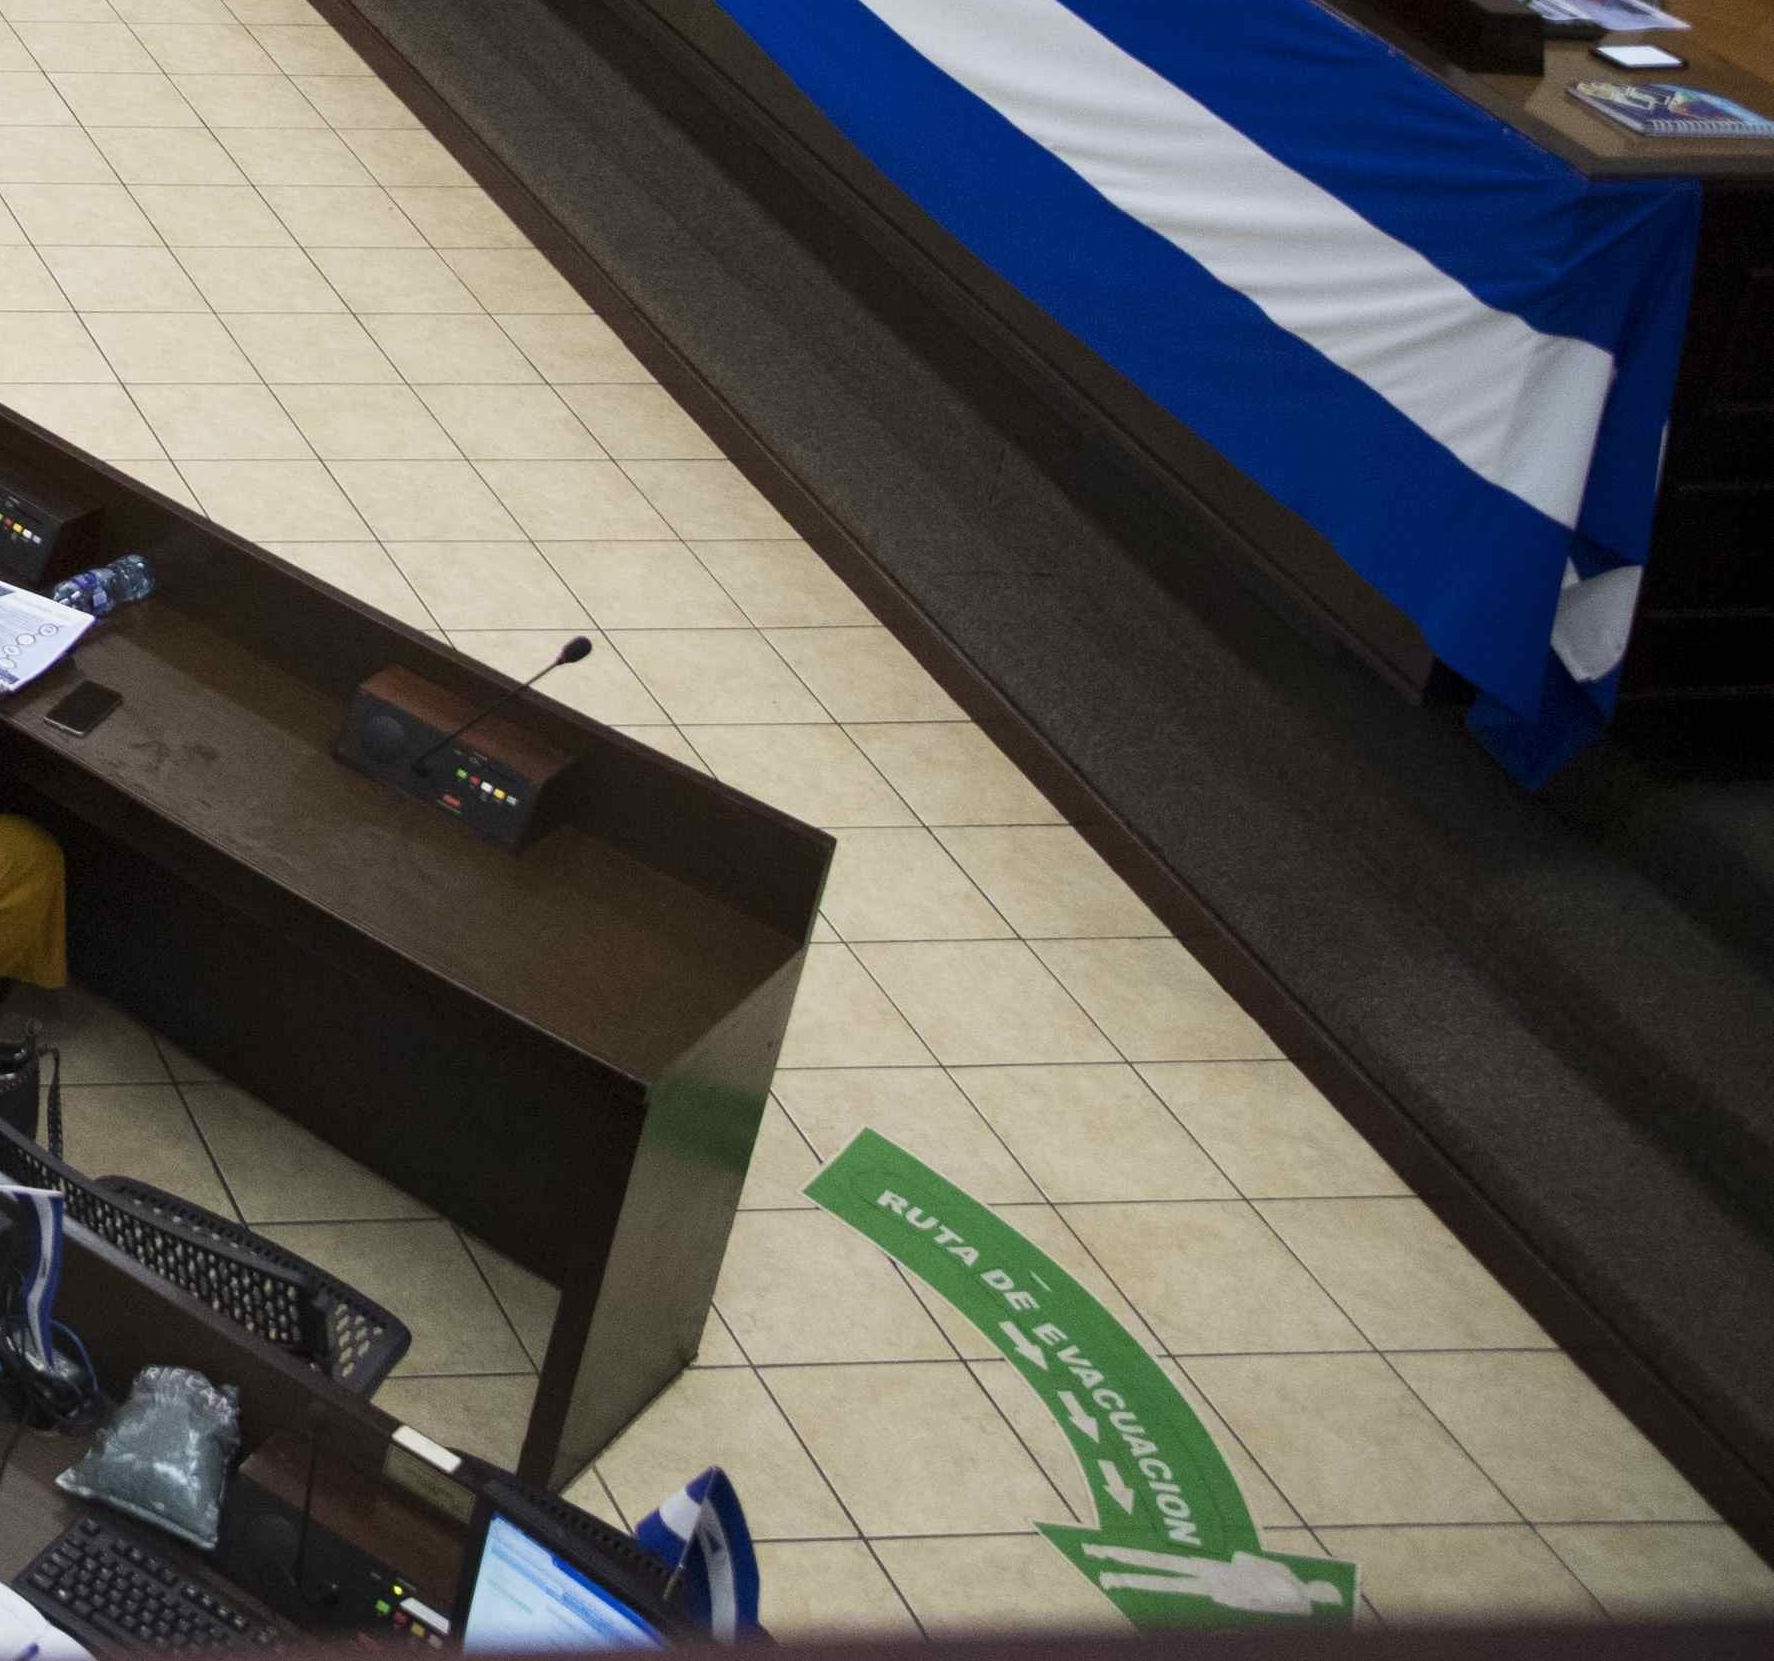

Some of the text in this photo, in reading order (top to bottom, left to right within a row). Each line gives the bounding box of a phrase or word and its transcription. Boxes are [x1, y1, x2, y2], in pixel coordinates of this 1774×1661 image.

[876, 1189, 1204, 1548] RUTA DE EVACUACION
